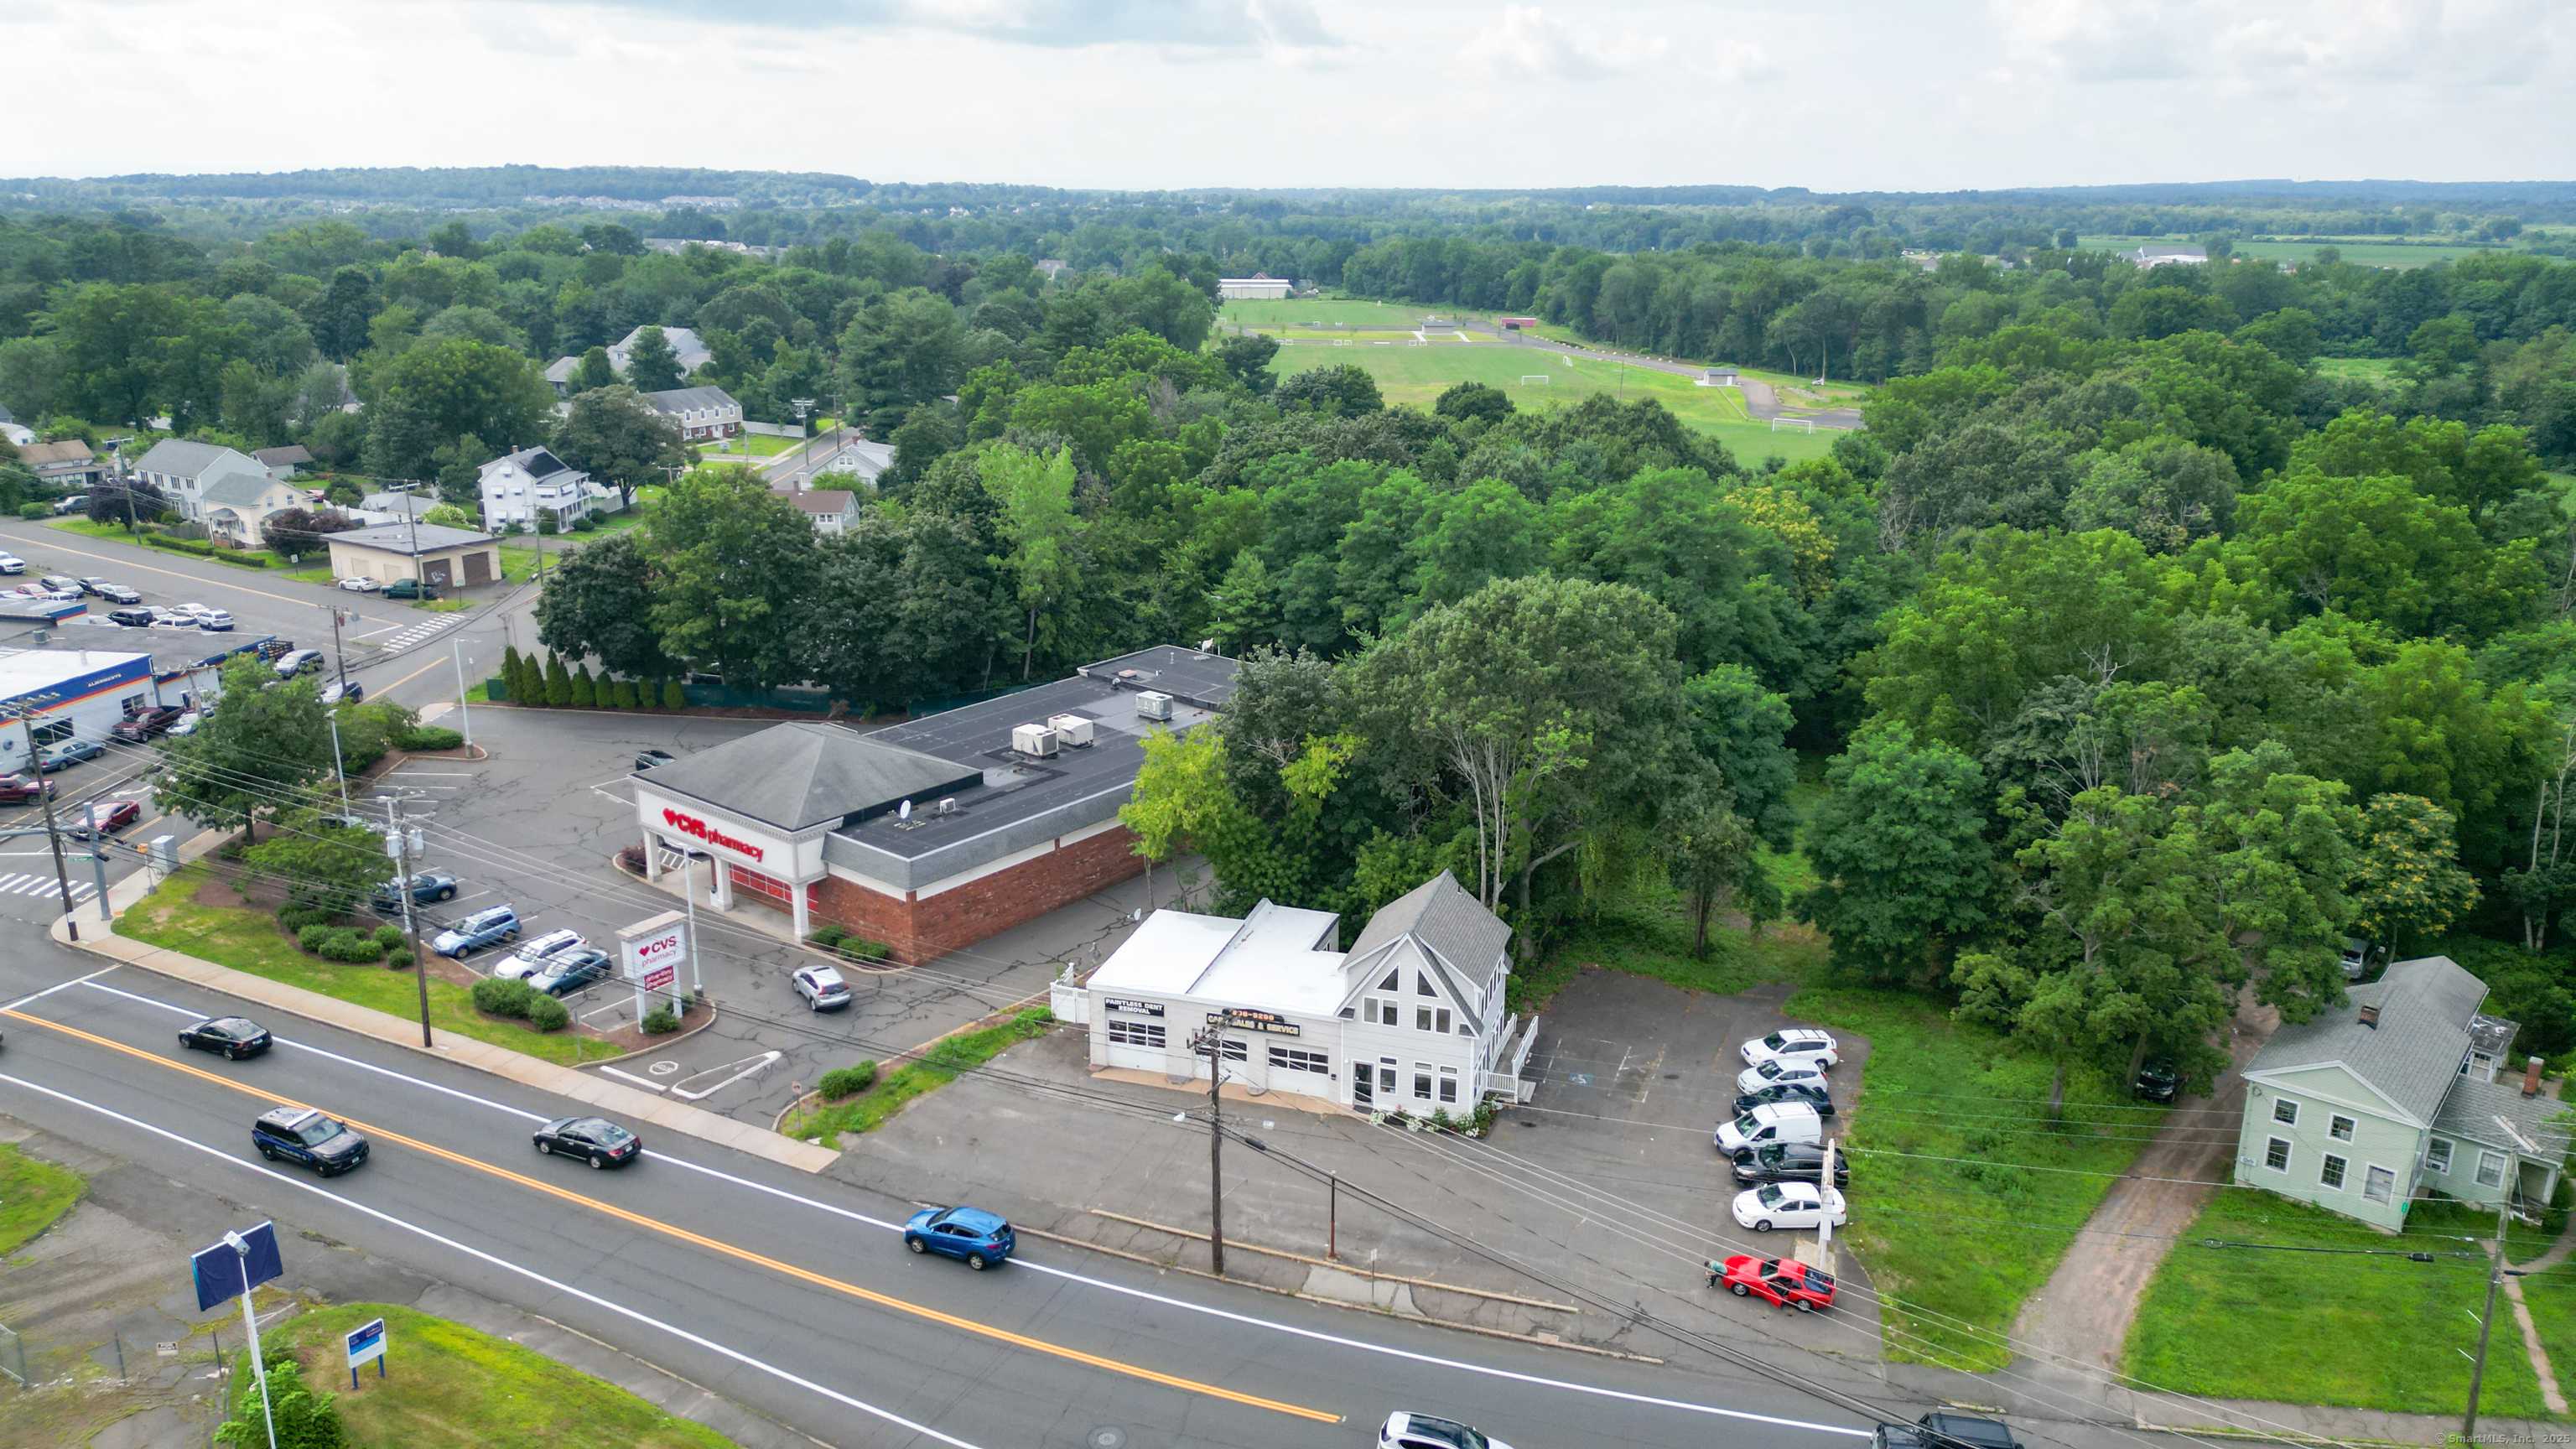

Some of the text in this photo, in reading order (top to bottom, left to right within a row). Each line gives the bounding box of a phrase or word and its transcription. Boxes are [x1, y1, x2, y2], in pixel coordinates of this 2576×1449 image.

[676, 813, 763, 862] CVS pharmacy
[652, 936, 677, 953] CVS
[642, 950, 677, 967] pharmacy
[1105, 998, 1143, 1008] PAINTLESS
[1118, 1005, 1150, 1014] REMOVAL
[1266, 1023, 1299, 1035] SERVICE
